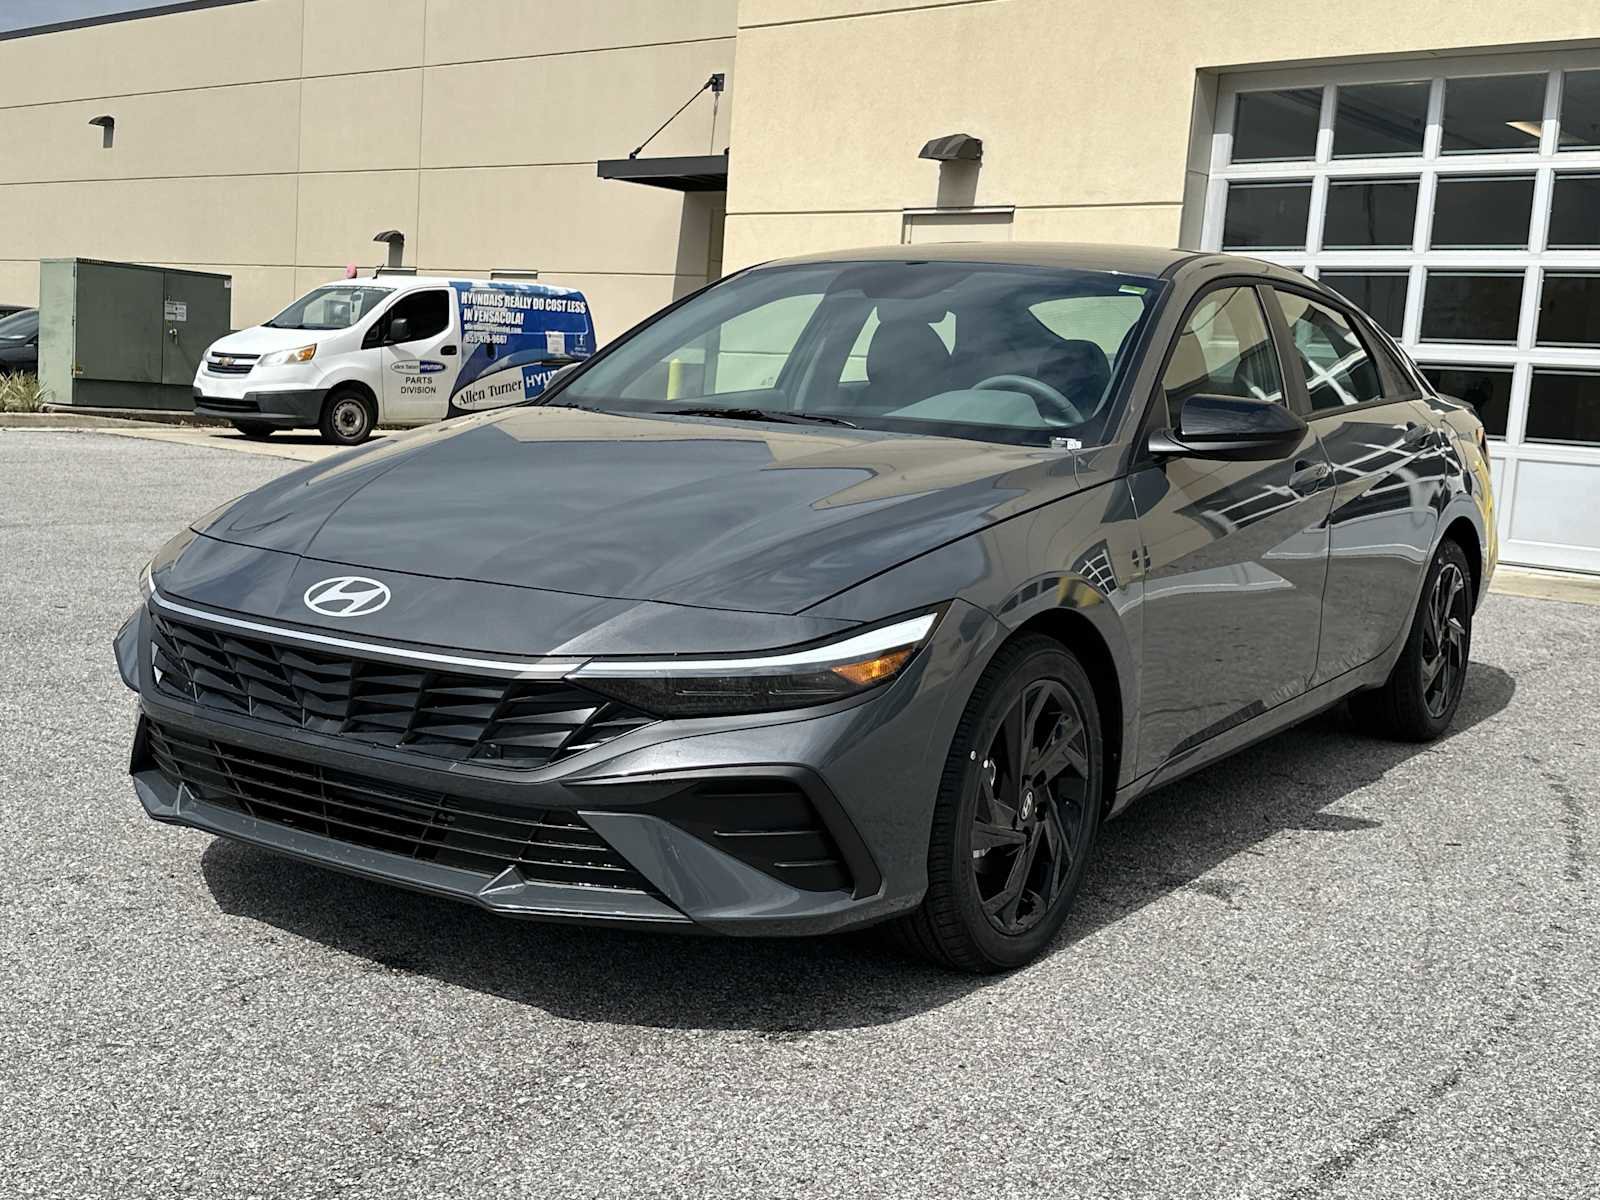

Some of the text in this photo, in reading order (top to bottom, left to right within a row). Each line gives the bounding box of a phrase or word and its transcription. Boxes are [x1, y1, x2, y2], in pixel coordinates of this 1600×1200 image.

[504, 295, 532, 309] REALLY
[533, 299, 545, 310] DO
[545, 299, 566, 312] COST
[567, 301, 586, 314] LESS
[464, 308, 473, 321] IN
[405, 376, 433, 385] PARTS
[400, 386, 437, 394] DIVISION
[459, 389, 486, 406] Allen
[488, 380, 522, 398] Turner
